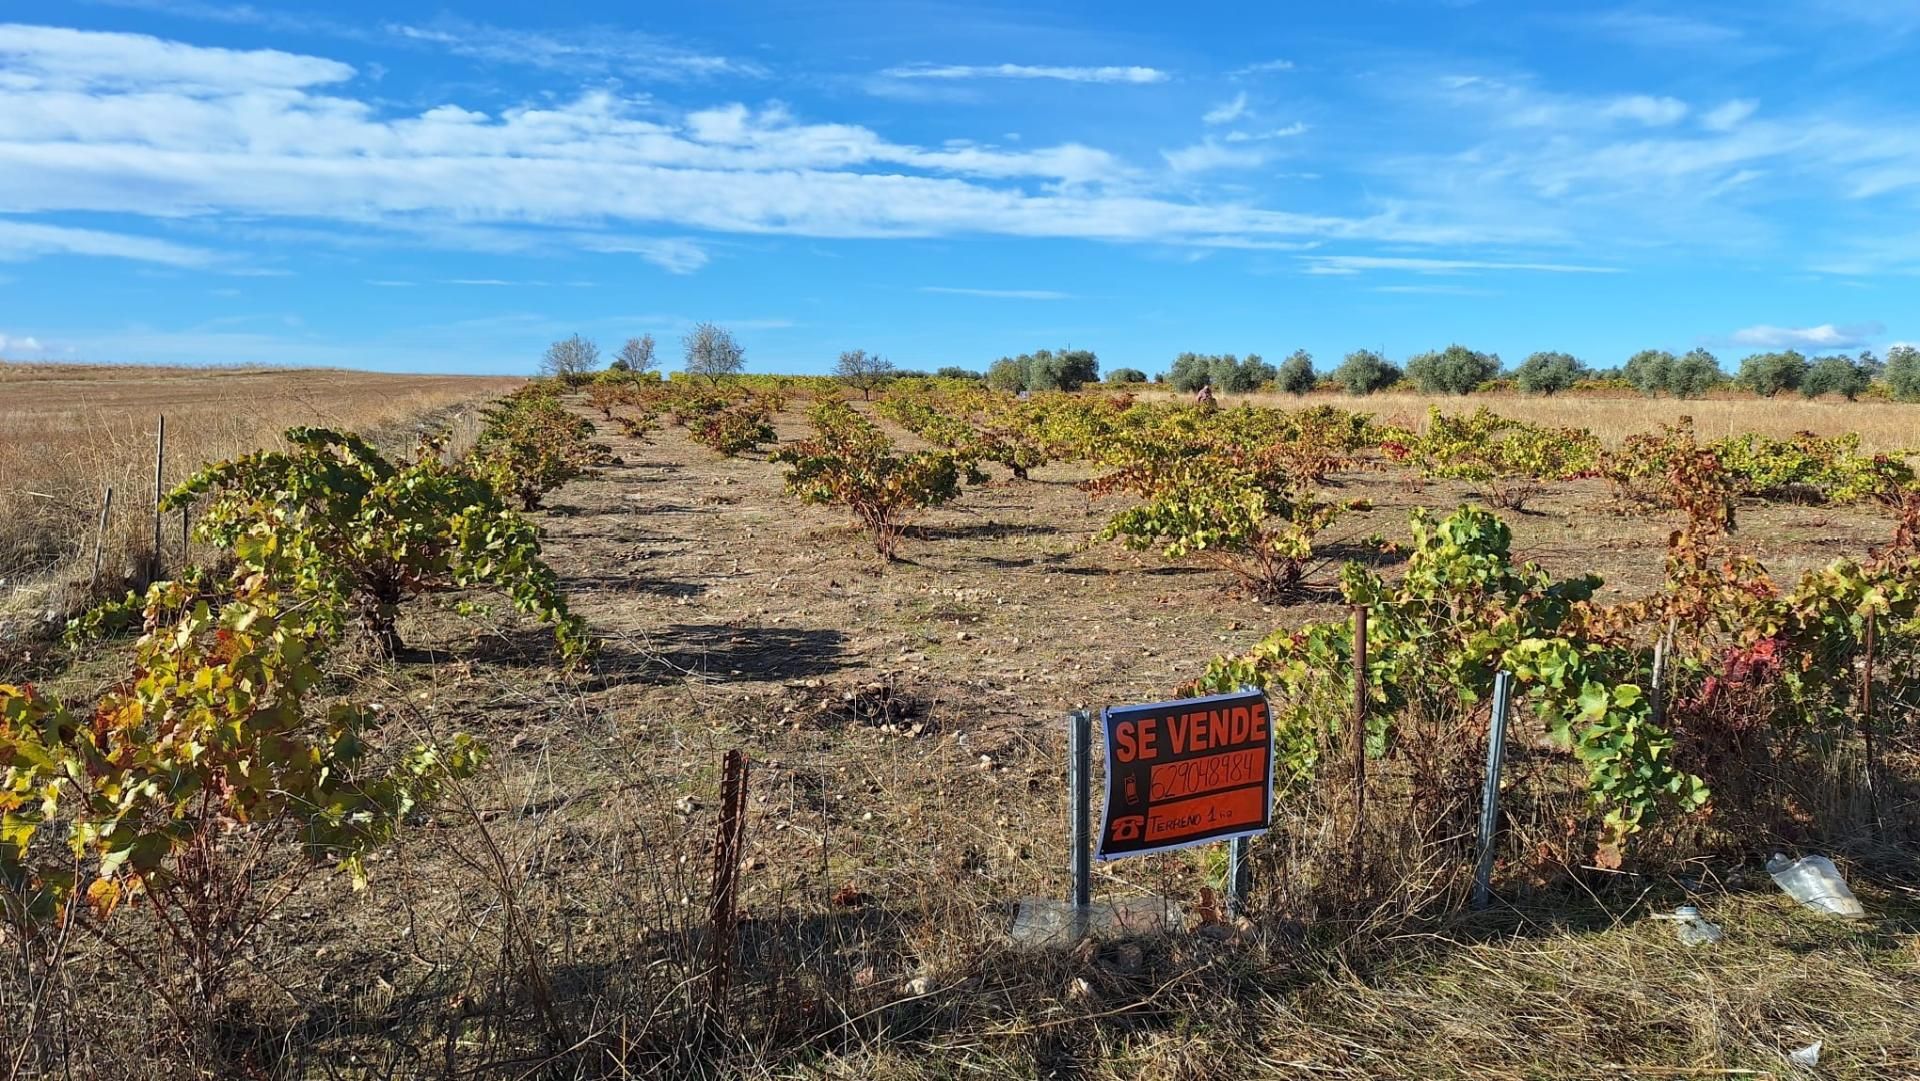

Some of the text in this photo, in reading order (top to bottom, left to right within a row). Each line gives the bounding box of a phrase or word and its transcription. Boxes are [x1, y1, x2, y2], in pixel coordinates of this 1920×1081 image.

[1116, 703, 1266, 763] SE VENDE
[1151, 753, 1254, 800] 629048984
[1207, 806, 1217, 823] 1
